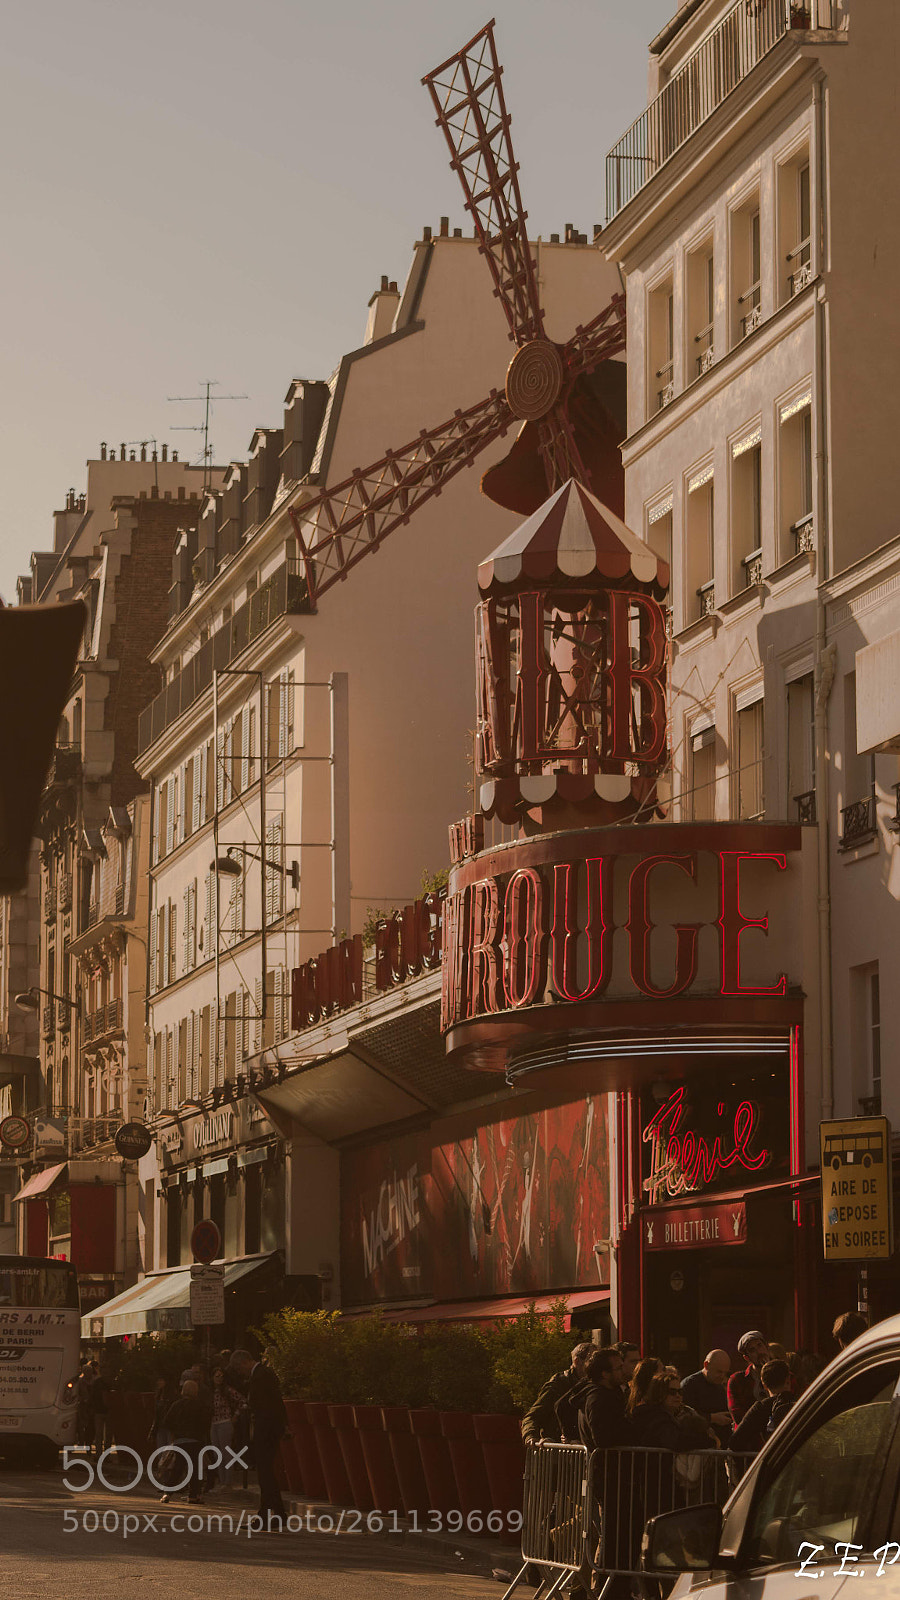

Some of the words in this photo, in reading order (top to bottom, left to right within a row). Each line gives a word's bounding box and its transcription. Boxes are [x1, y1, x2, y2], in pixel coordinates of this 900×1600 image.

[467, 851, 788, 1018] ROUGE
[831, 1180, 857, 1197] AIRE
[862, 1178, 877, 1194] DE
[362, 1162, 420, 1279] MACHINE
[664, 1218, 720, 1243] BILLETTERIE
[825, 1232, 839, 1248] EN
[845, 1230, 886, 1247] SOIREE
[80, 1287, 106, 1298] BAR
[23, 1313, 66, 1325] A.M.T.
[2, 1328, 14, 1336] DE
[17, 1328, 45, 1336] BERRI
[7, 1337, 34, 1345] PARIS
